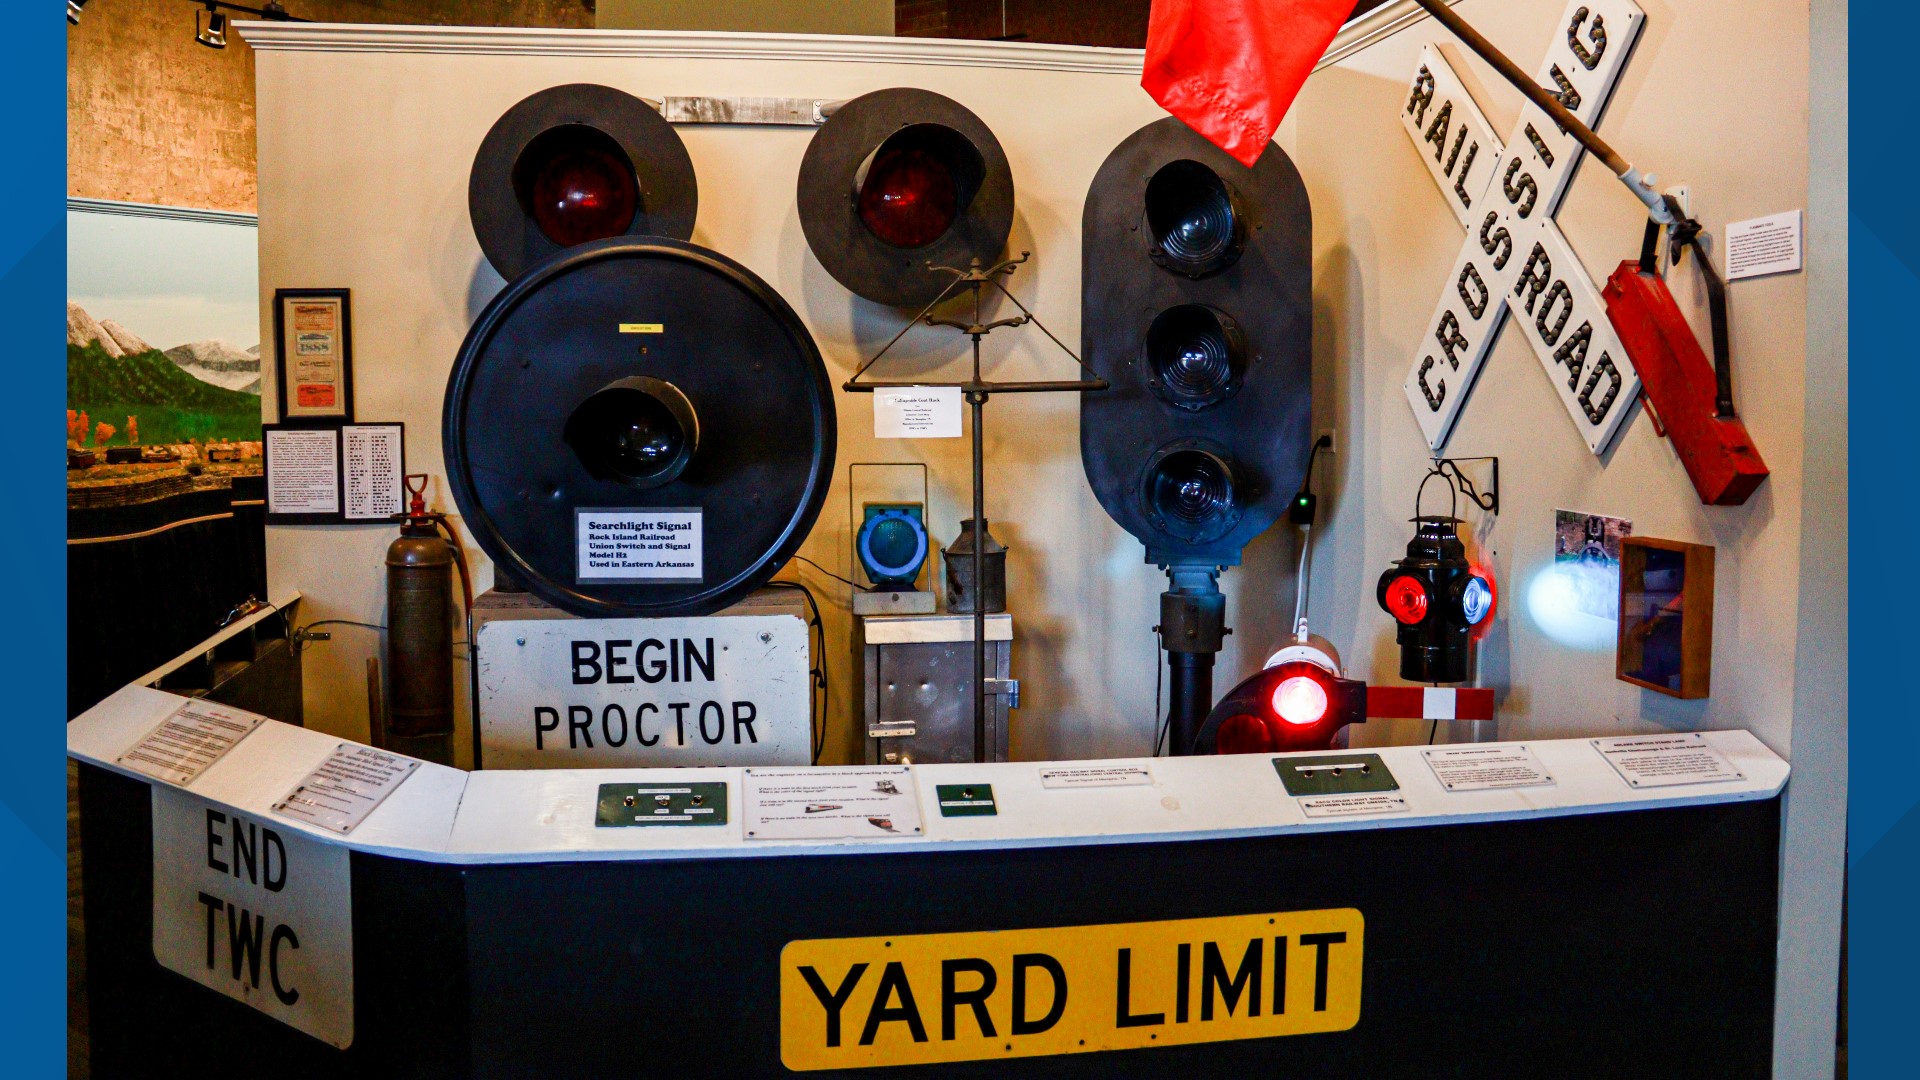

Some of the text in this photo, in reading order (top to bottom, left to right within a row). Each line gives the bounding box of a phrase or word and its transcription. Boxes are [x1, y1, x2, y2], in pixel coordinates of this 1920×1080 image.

[1406, 63, 1623, 426] RAIL ROAD
[1418, 5, 1607, 412] CROSSING
[588, 522, 692, 532] Searchlight Signal
[571, 637, 716, 685] BEGIN
[534, 700, 758, 750] PROCTOR
[207, 808, 288, 893] END
[199, 891, 300, 1006] TWC
[796, 931, 1347, 1048] YARD LIMIT
